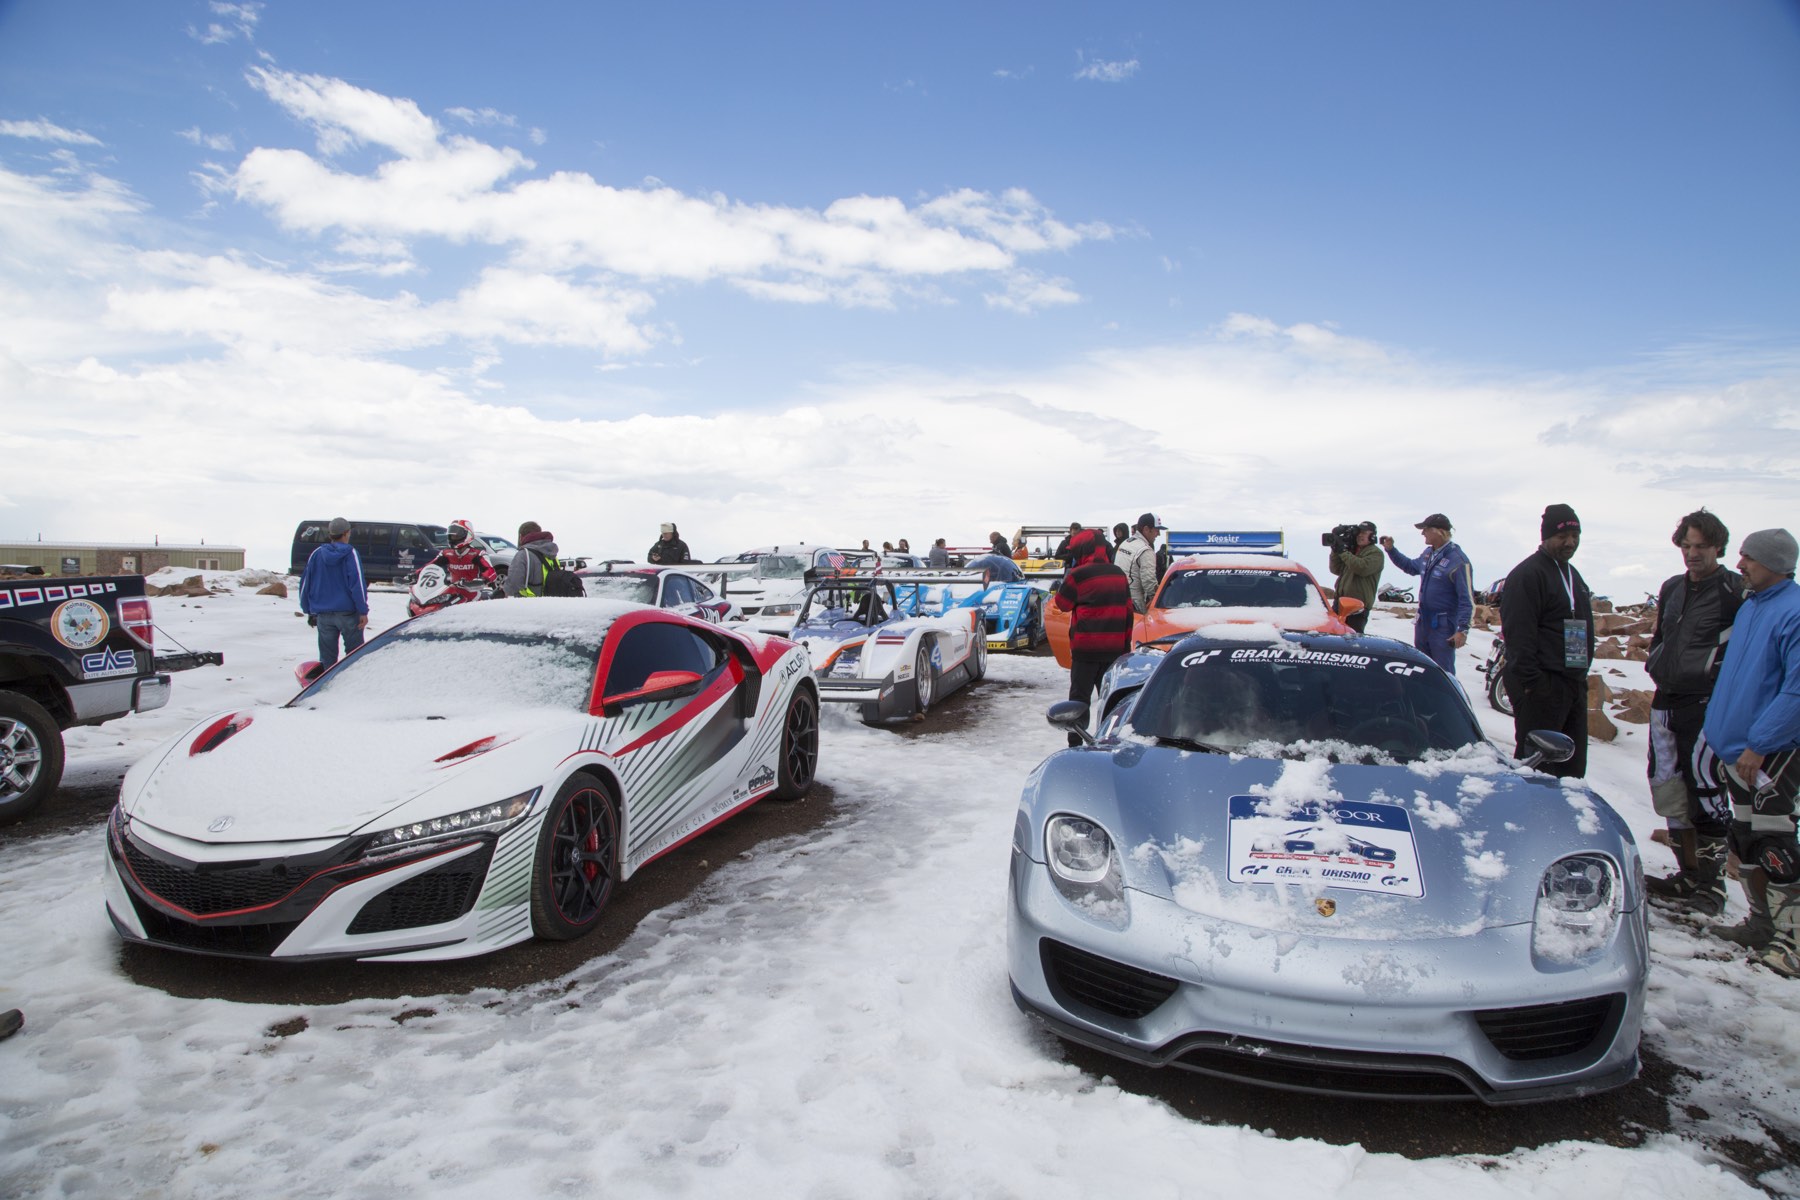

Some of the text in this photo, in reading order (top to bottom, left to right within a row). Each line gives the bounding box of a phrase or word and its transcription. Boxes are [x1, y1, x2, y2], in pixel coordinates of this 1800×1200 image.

[1206, 534, 1240, 543] Hoosier
[449, 563, 475, 571] DUCATI
[420, 575, 440, 588] 75
[65, 635, 98, 647] Rescue Tools
[1230, 649, 1286, 659] GRAN
[1288, 650, 1371, 666] TURISMO
[1312, 660, 1367, 669] SIMULATOR
[671, 822, 690, 840] PACE
[692, 812, 706, 827] CAR
[1276, 866, 1310, 875] GRN
